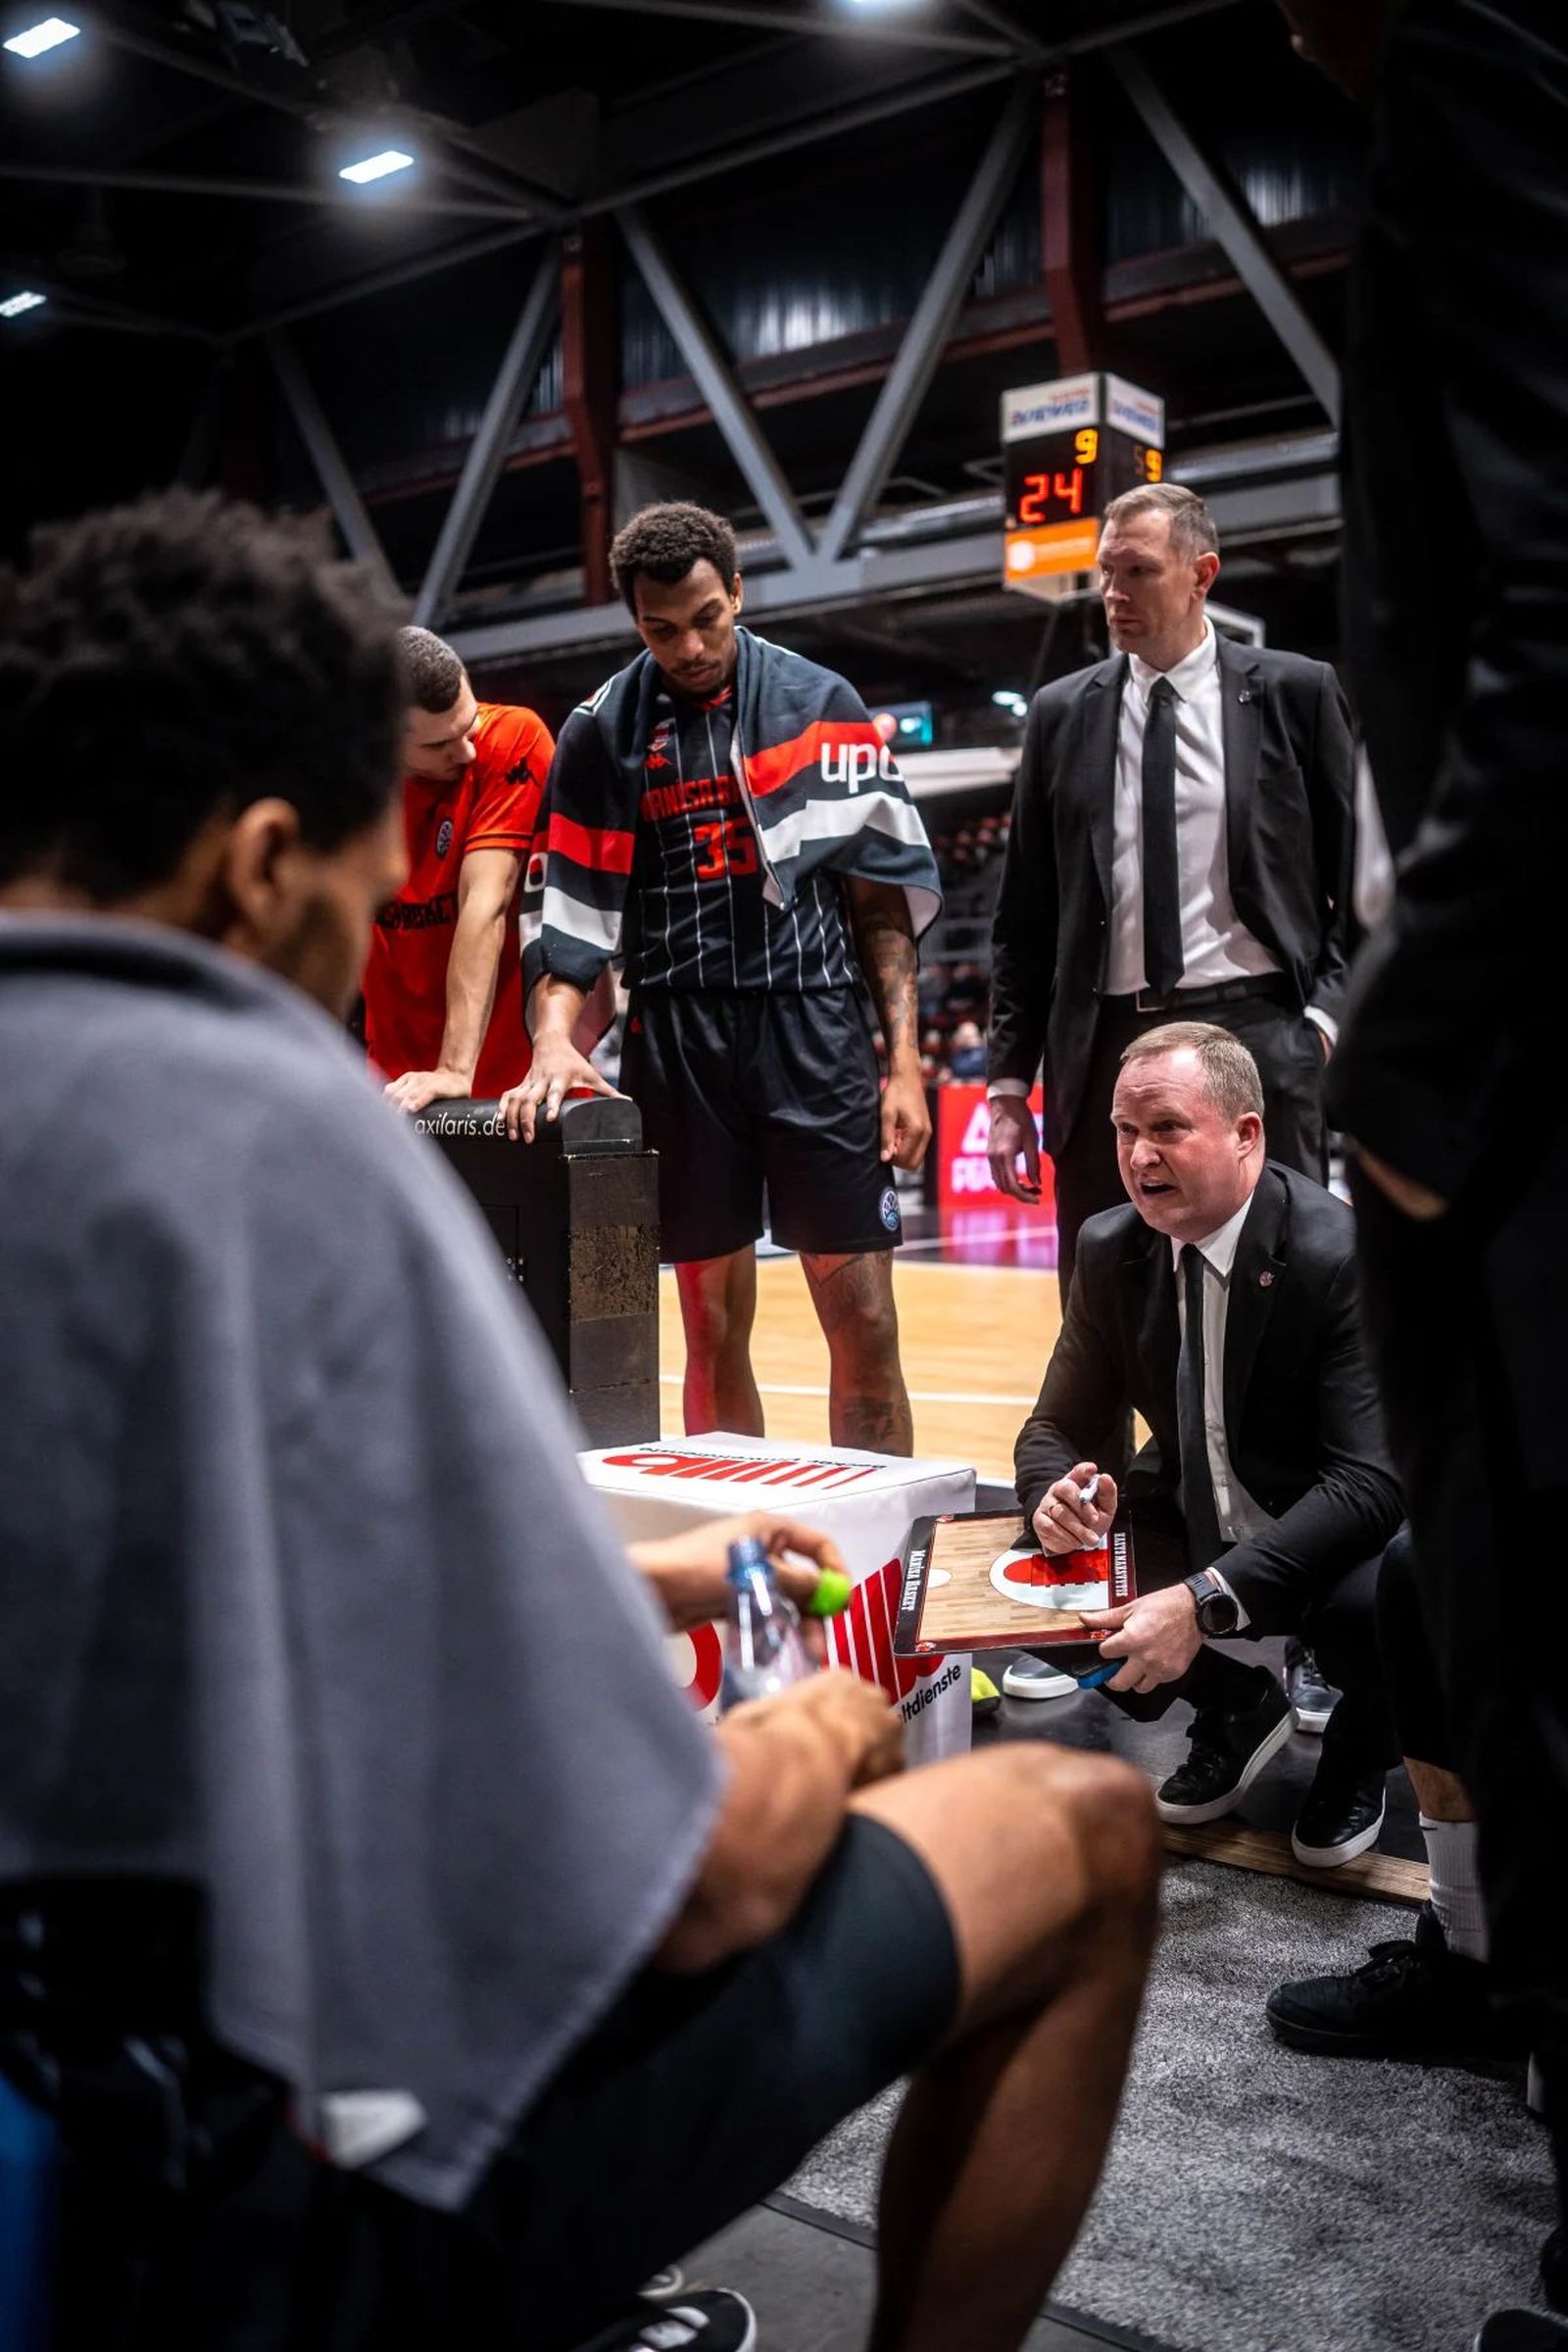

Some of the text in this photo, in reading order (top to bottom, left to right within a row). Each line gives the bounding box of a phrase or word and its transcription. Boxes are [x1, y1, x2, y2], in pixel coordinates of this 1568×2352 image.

[1076, 428, 1098, 464] 9
[1146, 449, 1162, 482] 9
[1019, 467, 1084, 523] 24
[693, 817, 759, 880] 35
[415, 1111, 506, 1137] axilaris.de
[899, 1663, 961, 1724] ltdienste
